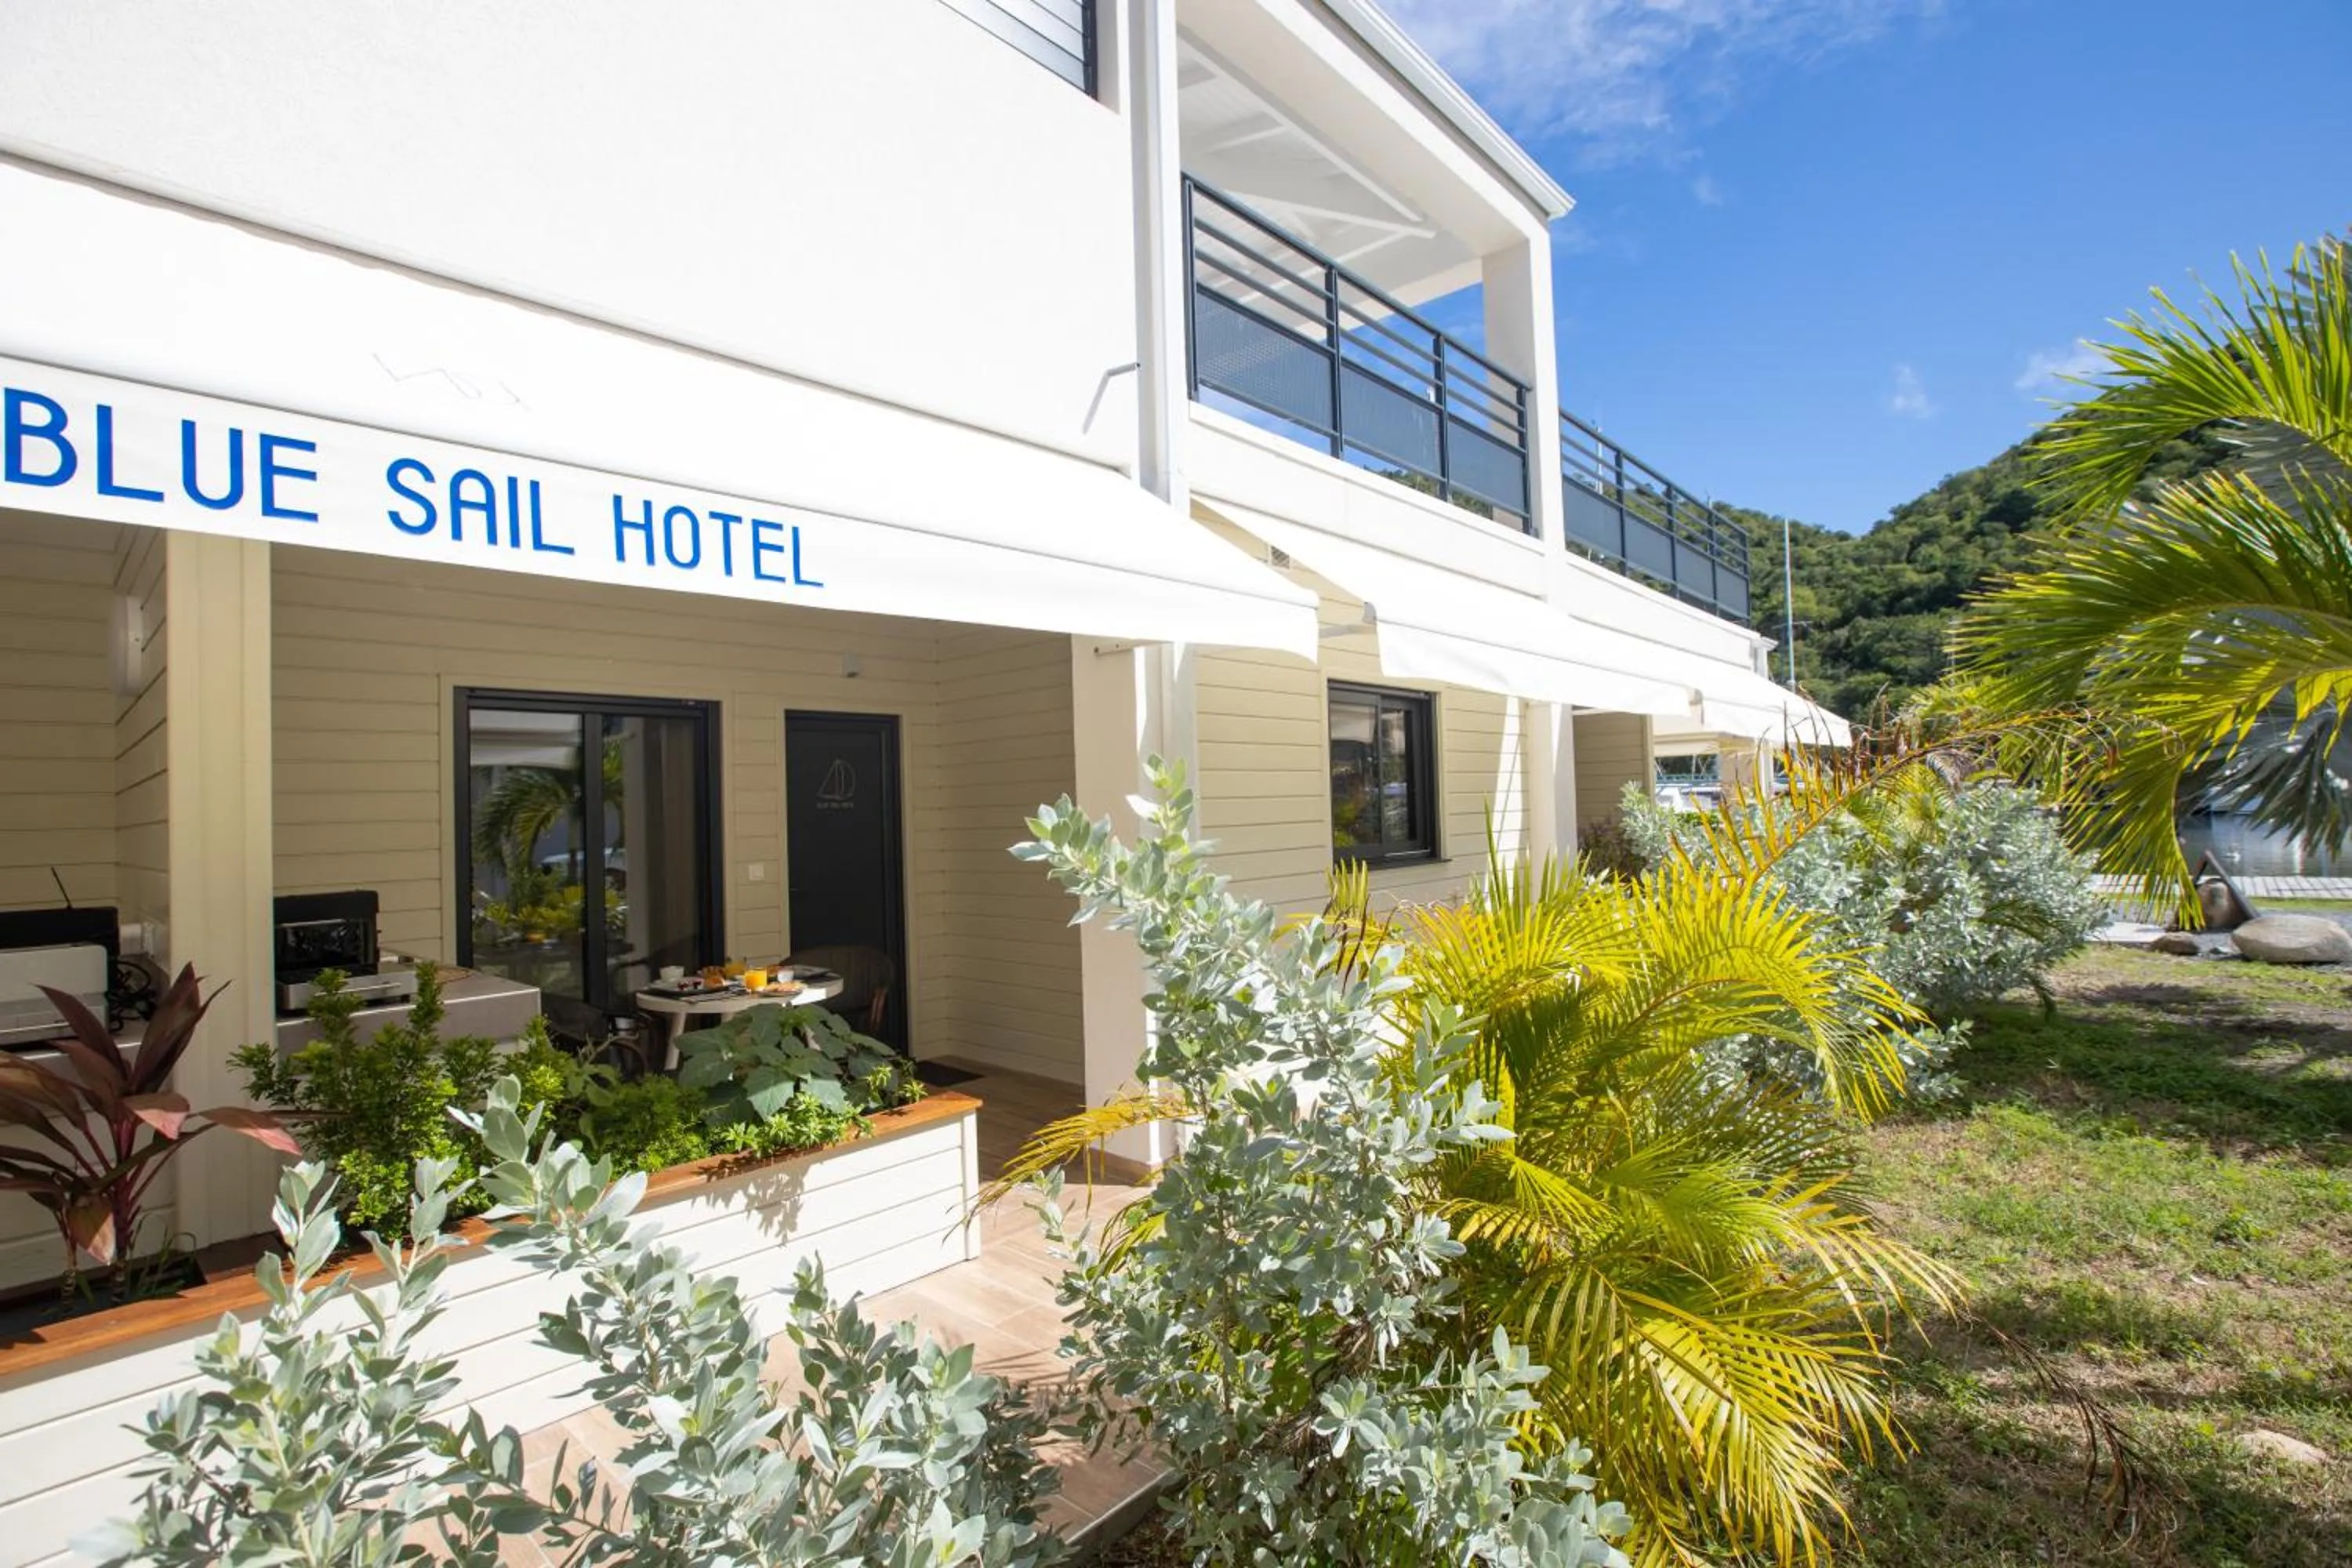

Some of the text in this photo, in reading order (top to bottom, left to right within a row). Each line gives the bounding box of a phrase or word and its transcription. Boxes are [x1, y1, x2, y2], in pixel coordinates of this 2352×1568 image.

[4, 387, 823, 587] BLUE SAIL HOTEL
